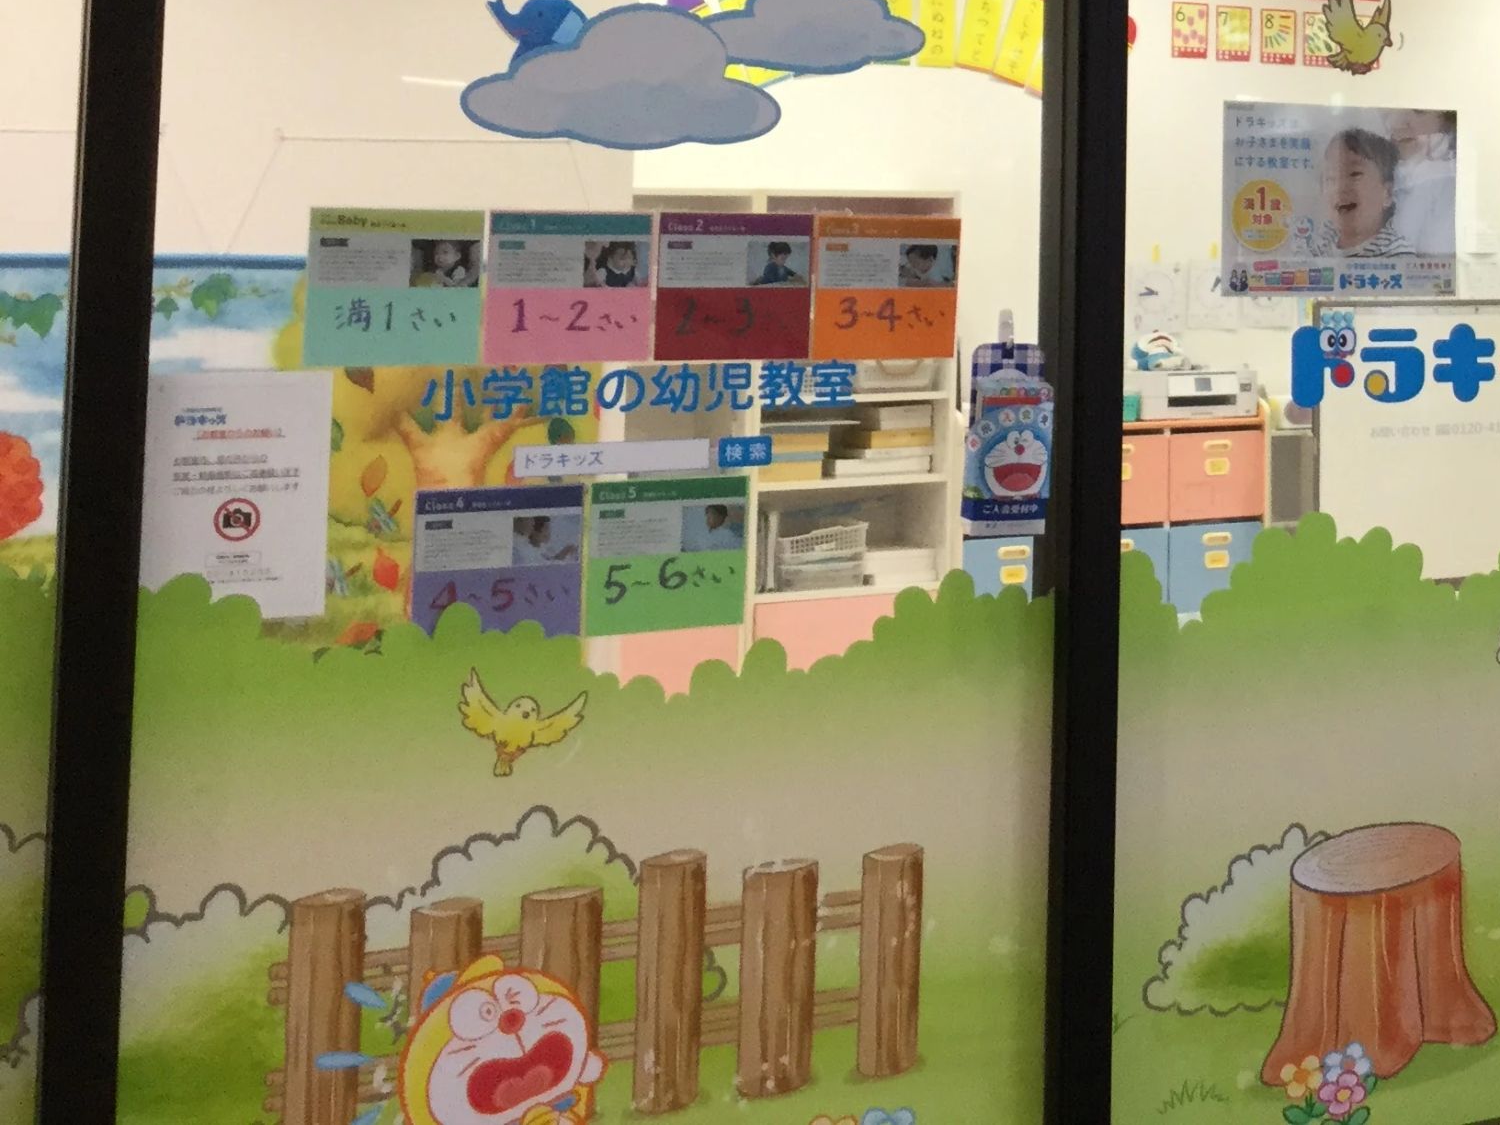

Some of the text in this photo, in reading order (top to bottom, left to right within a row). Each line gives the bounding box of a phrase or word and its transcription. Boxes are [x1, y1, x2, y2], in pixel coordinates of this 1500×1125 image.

[1175, 6, 1186, 23] 6
[1218, 11, 1229, 26] 7
[1264, 13, 1275, 30] 8
[1338, 273, 1403, 291] ドラキッズ
[421, 359, 858, 421] 小学館の幼児教室
[522, 440, 769, 470] ドラキッズ 検索
